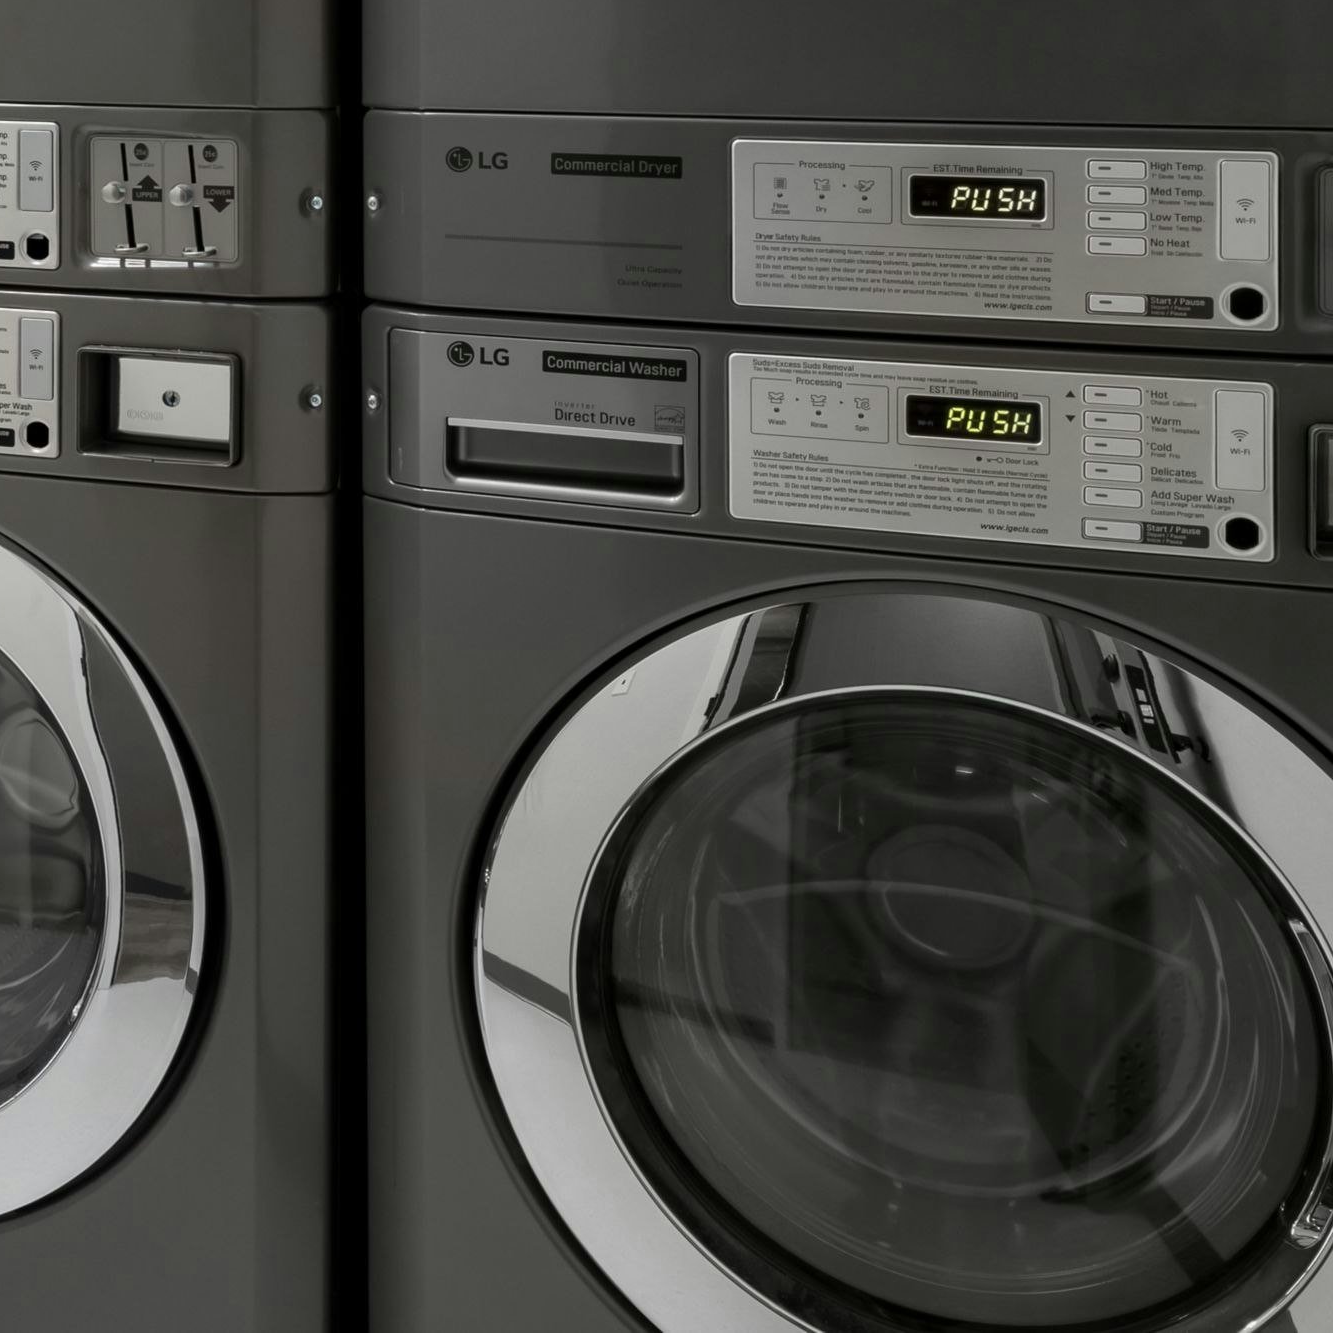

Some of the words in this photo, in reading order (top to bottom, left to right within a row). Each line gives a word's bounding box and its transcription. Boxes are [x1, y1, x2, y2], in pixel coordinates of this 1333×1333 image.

[479, 152, 508, 170] LG
[799, 160, 845, 170] Processing
[555, 157, 635, 173] Commercial
[639, 160, 678, 176] Dryer
[976, 166, 1023, 175] Remaining
[1150, 162, 1172, 172] High
[1175, 162, 1205, 172] Temp.
[1150, 188, 1171, 196] Med
[1175, 188, 1205, 198] Temp.
[951, 186, 1036, 212] PUSH
[1150, 213, 1171, 222] Low
[1175, 214, 1205, 224] Temp.
[756, 233, 773, 241] Dryer
[776, 233, 799, 242] Safety
[801, 234, 821, 242] Rules
[1150, 238, 1164, 247] No
[1167, 239, 1189, 248] Heat
[1151, 297, 1171, 305] Start
[1180, 298, 1205, 307] Pause
[480, 348, 510, 366] LG
[547, 355, 625, 373] Commercial
[628, 361, 682, 377] Washer
[824, 363, 854, 372] Removal
[796, 377, 842, 388] Processing
[972, 389, 1018, 399] Remaining
[1151, 390, 1168, 399] Hot
[555, 409, 595, 423] Direct
[600, 412, 635, 427] Drive
[947, 407, 1031, 434] PUSH
[1151, 416, 1181, 426] Warm
[811, 421, 828, 429] Rinse
[855, 424, 869, 432] Spin
[1151, 442, 1172, 452] Cold
[753, 450, 780, 458] Washer
[783, 452, 806, 461] Safety
[809, 453, 828, 461] Rules
[1151, 467, 1196, 478] Delicates
[1151, 490, 1170, 500] Add
[1173, 492, 1202, 503] Super
[1205, 494, 1234, 504] Wash
[1177, 510, 1204, 519] Program
[1147, 524, 1168, 533] Start
[1176, 526, 1201, 535] Pause
